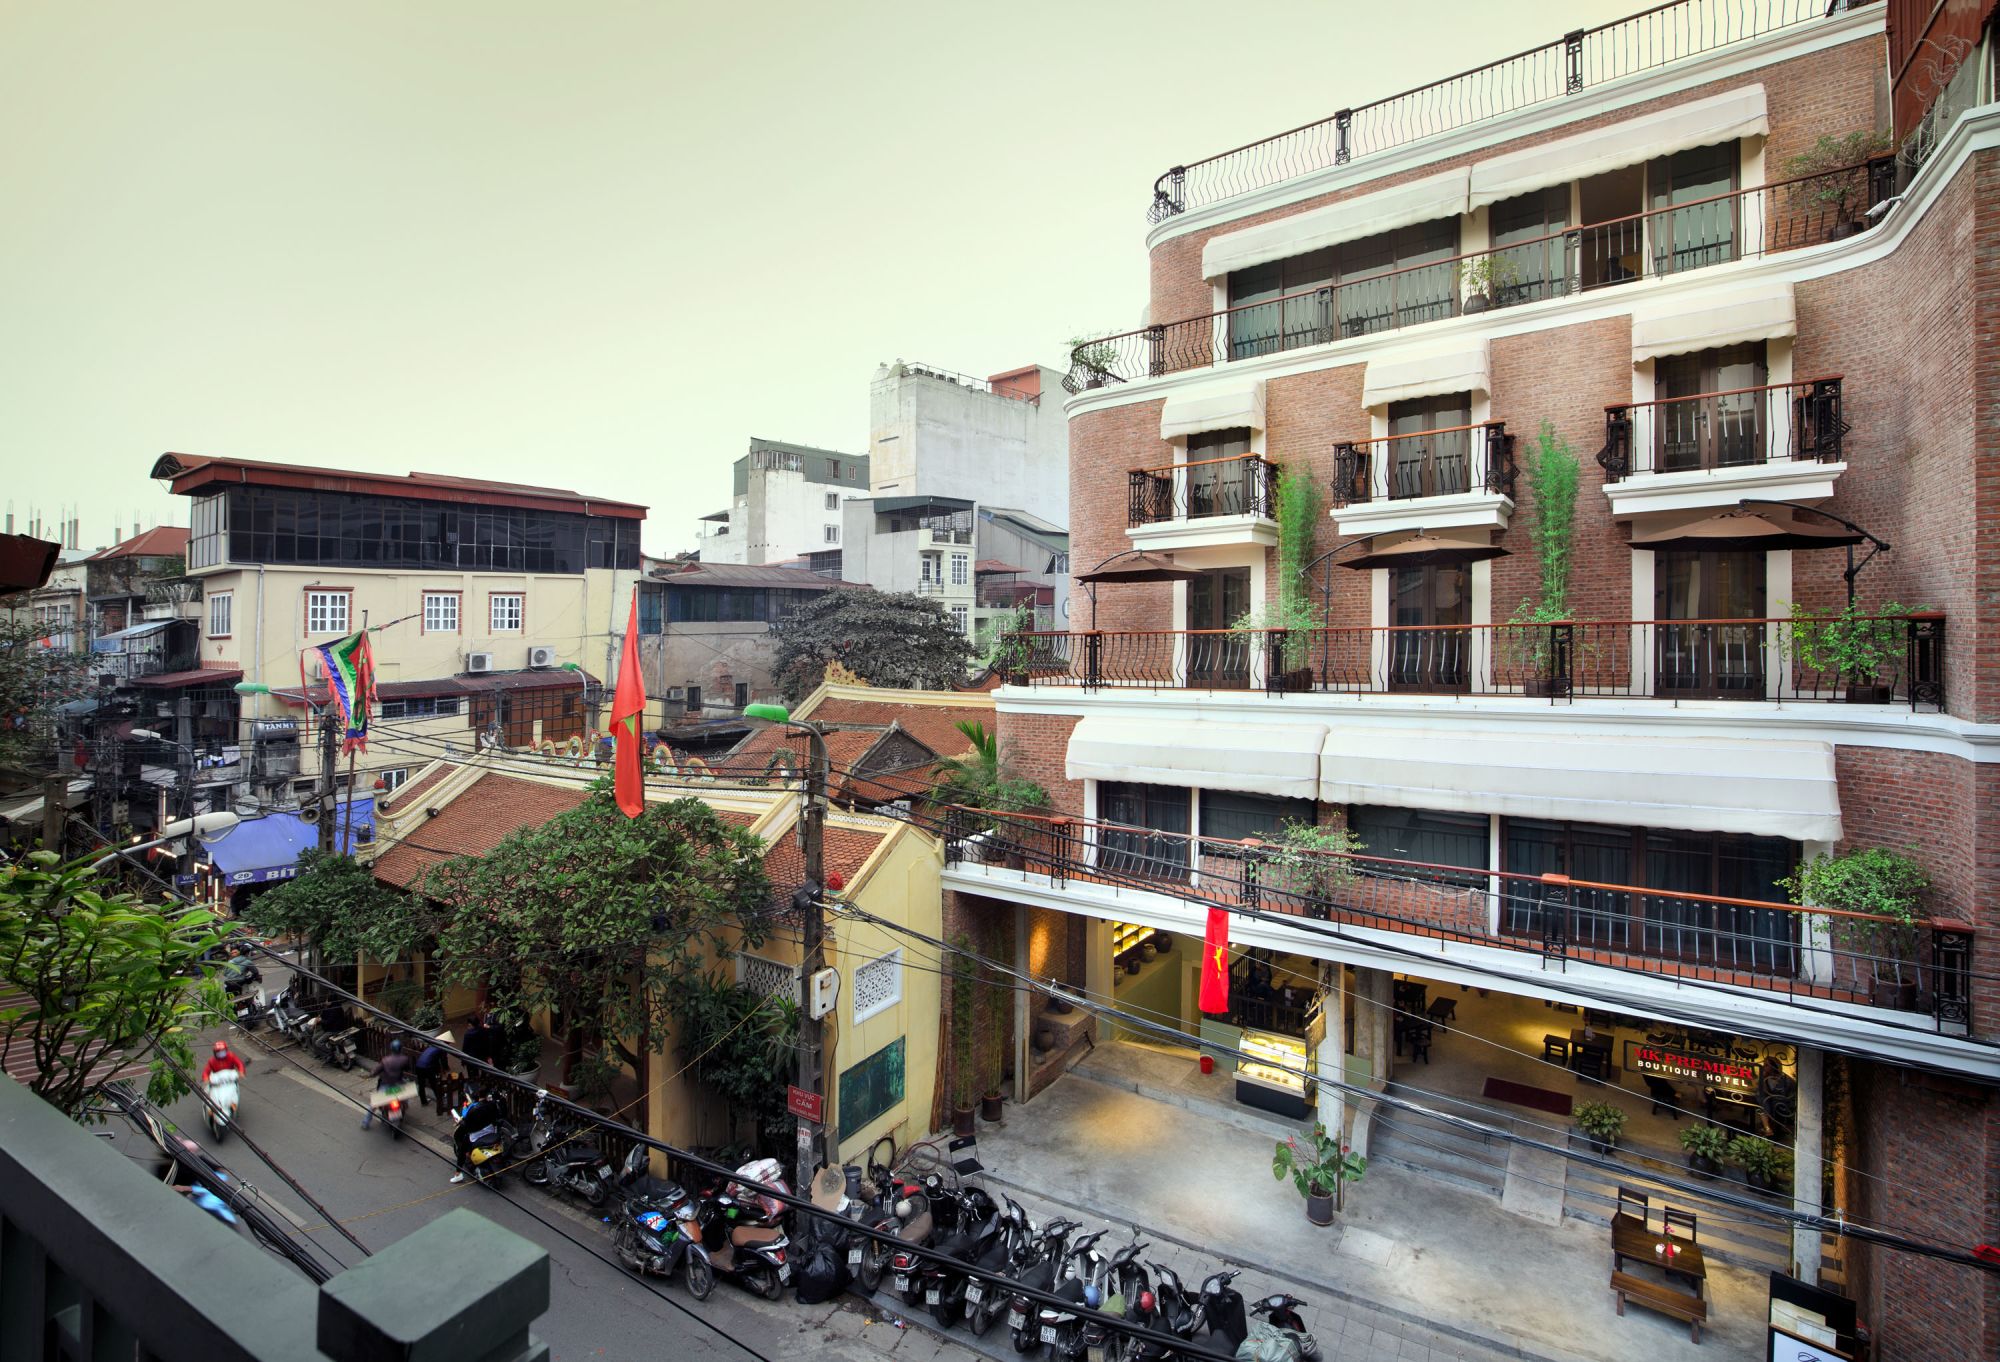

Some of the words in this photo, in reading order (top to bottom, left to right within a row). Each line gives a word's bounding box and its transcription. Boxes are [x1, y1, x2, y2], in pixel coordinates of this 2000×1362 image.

[1633, 1047, 1661, 1062] MK
[1664, 1053, 1752, 1079] PREMIER
[1637, 1060, 1697, 1078] BOUTIQUE
[1706, 1073, 1748, 1087] HOTEL
